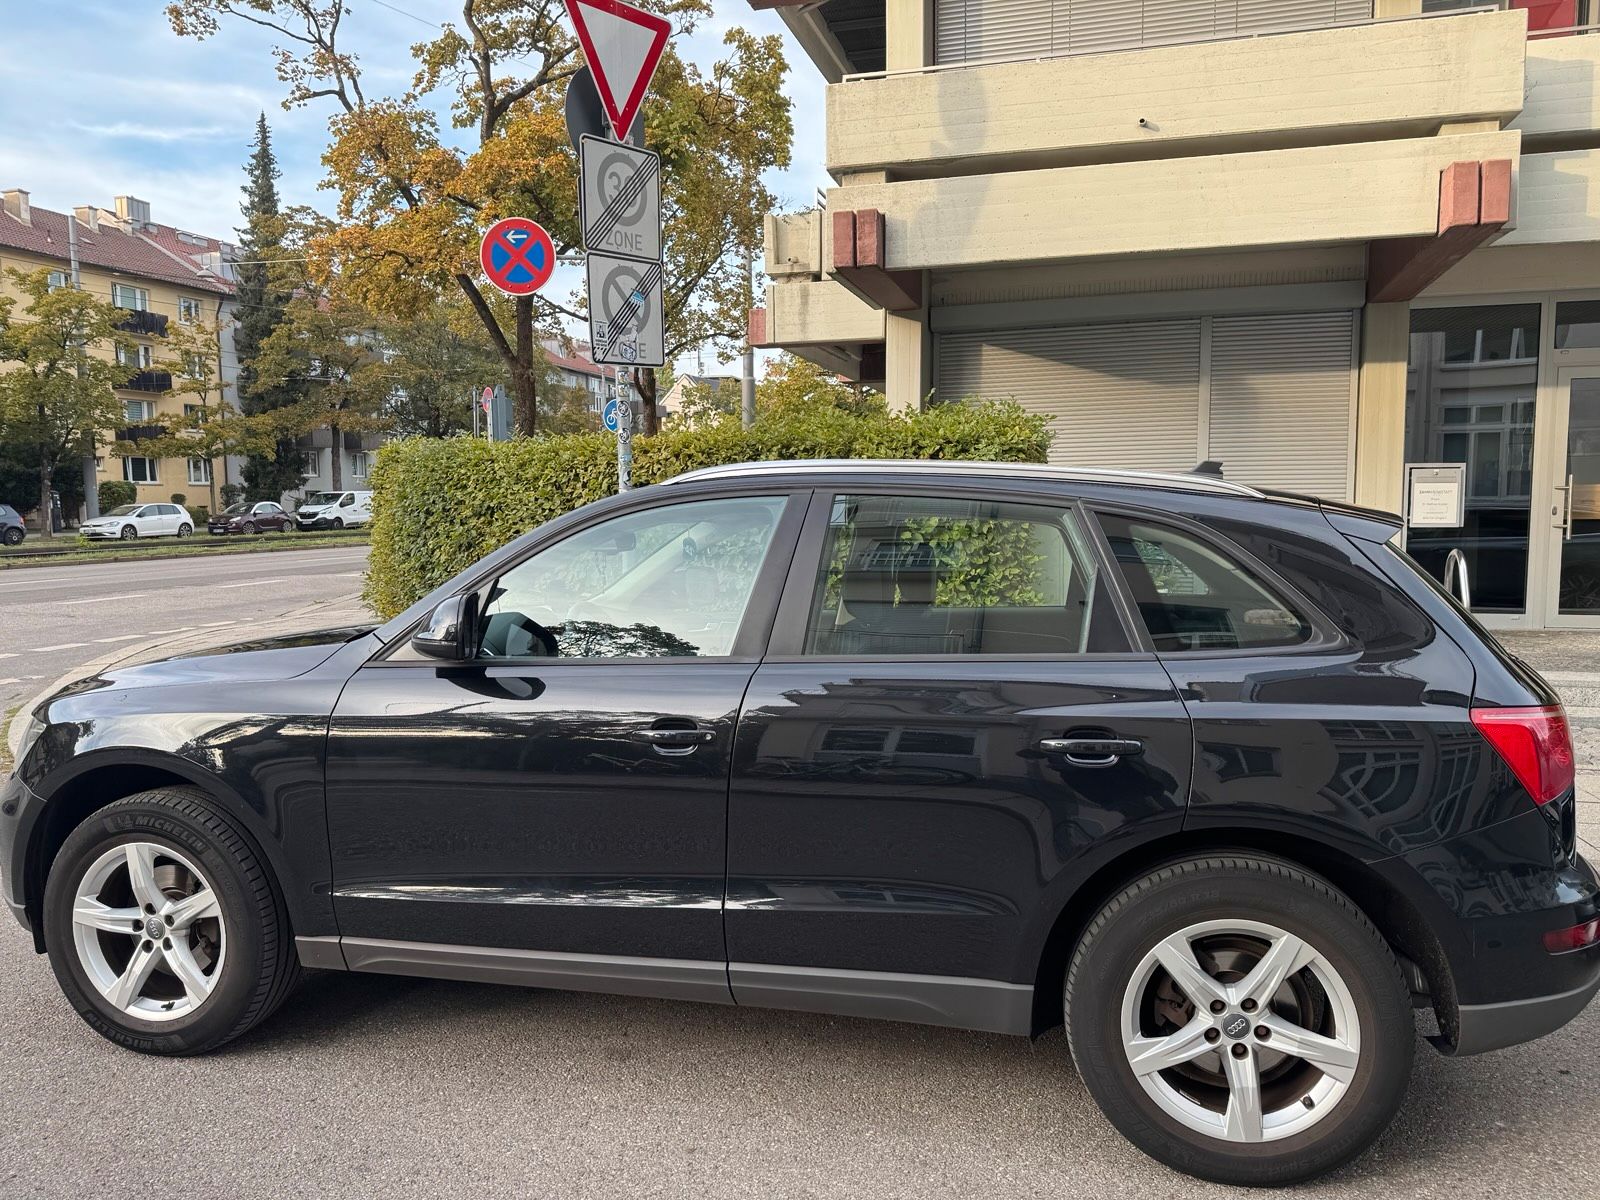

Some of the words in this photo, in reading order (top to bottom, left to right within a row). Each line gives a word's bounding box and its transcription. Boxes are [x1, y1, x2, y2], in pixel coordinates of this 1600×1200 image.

[606, 228, 643, 251] ZONE
[611, 341, 647, 359] ZE
[135, 814, 208, 852] MICHELIN
